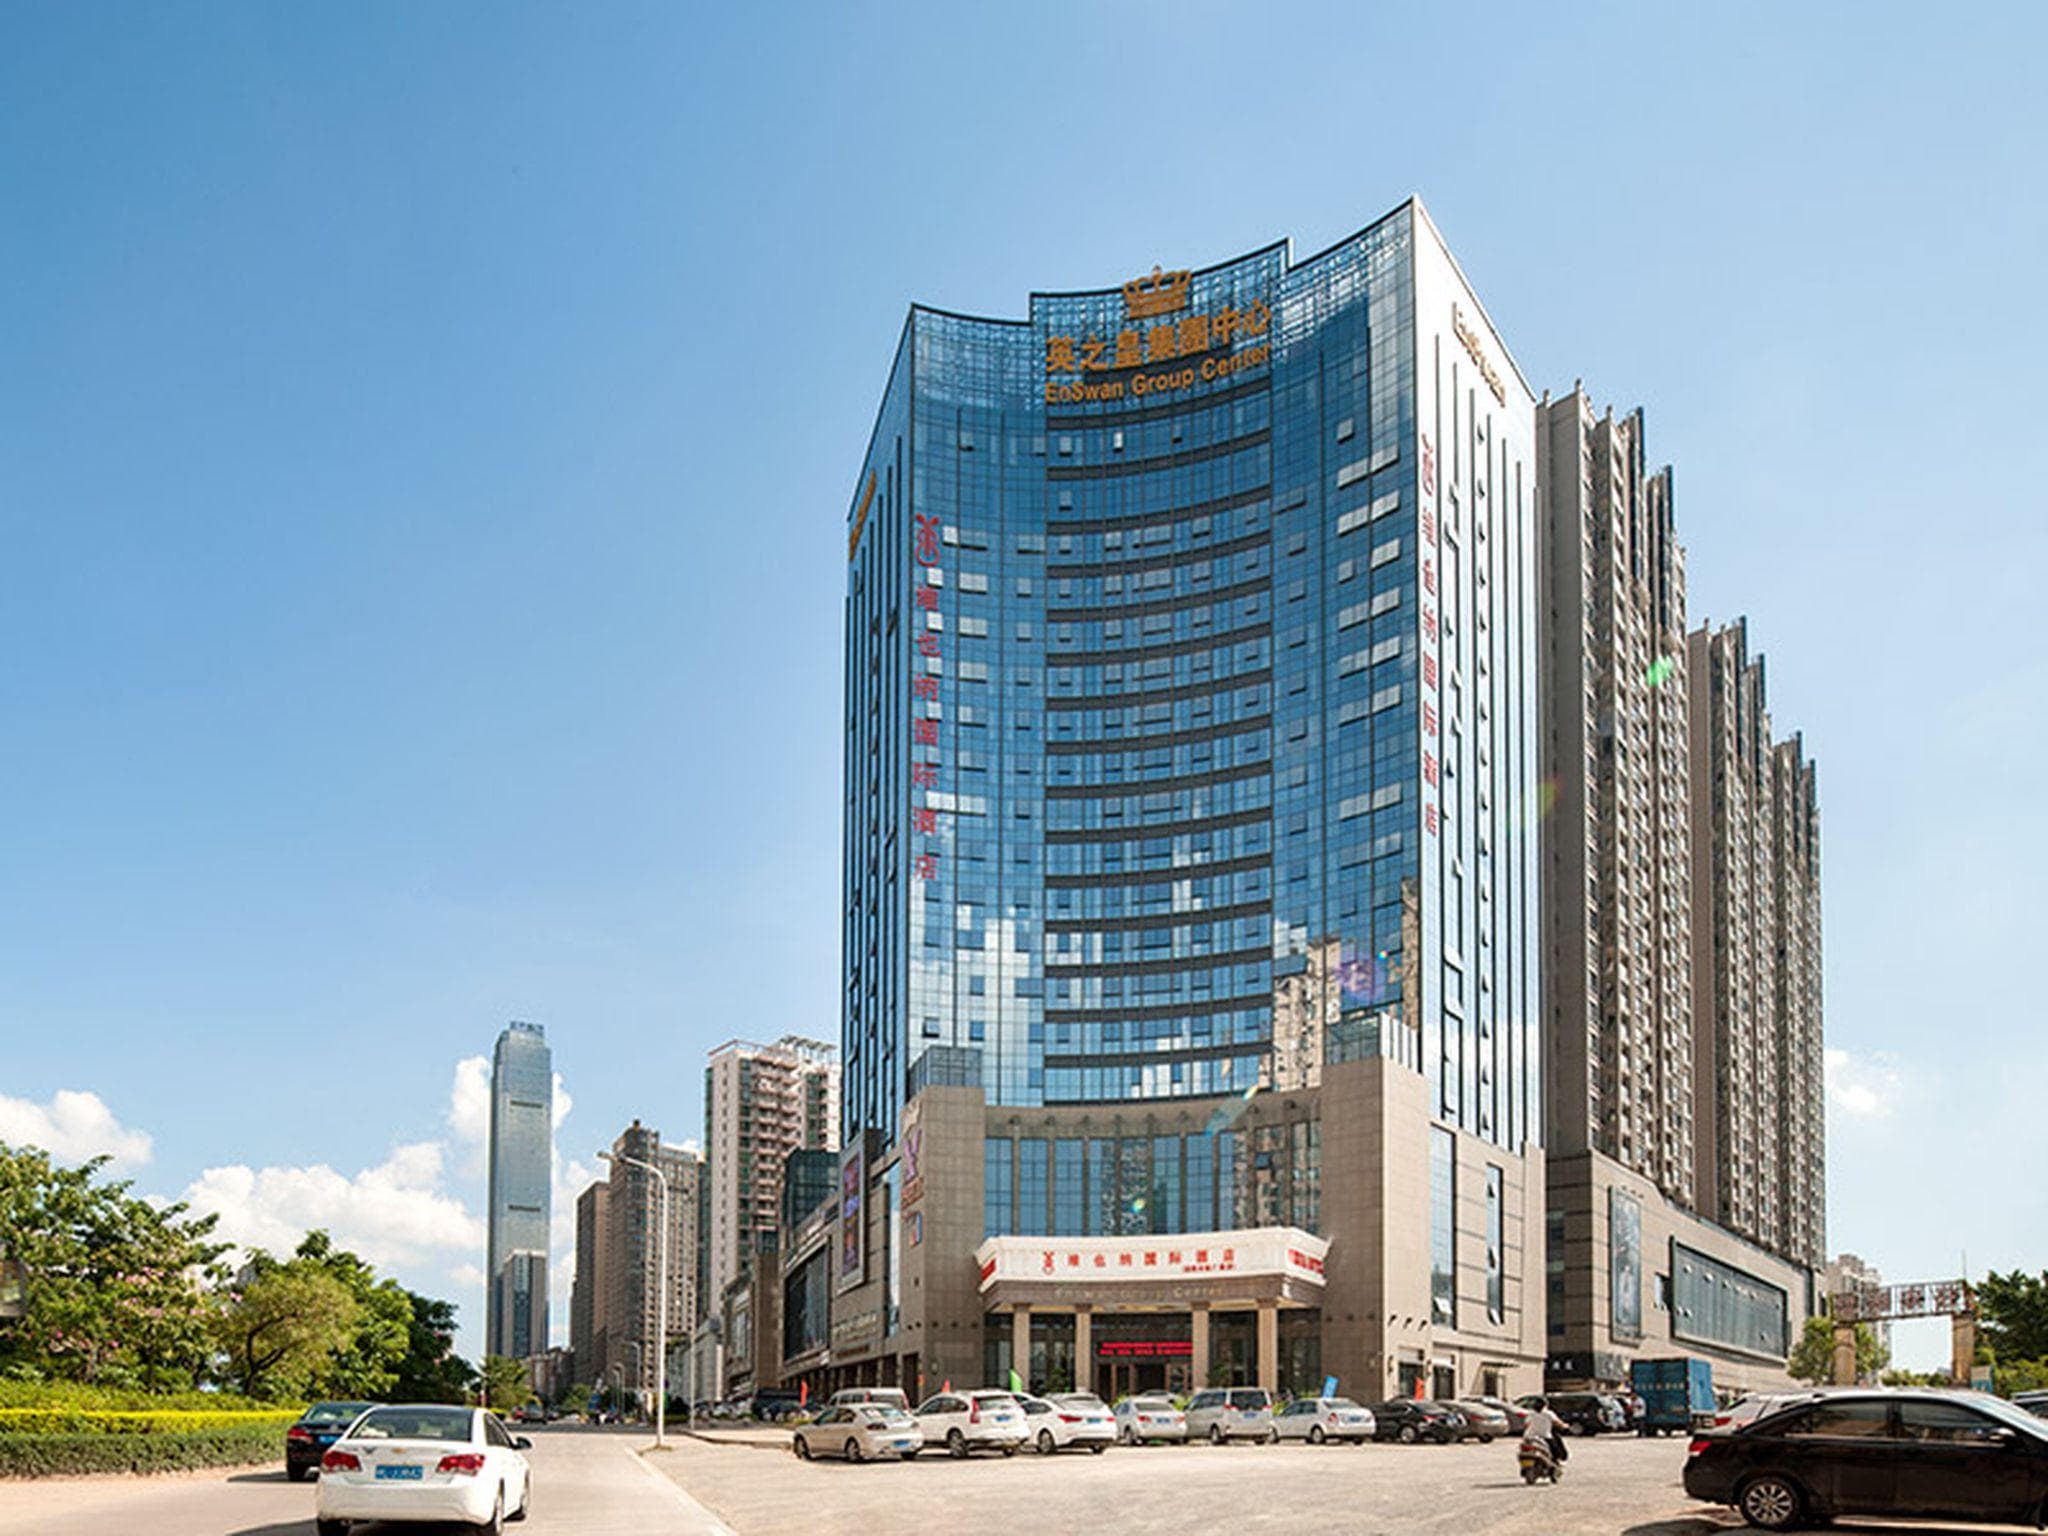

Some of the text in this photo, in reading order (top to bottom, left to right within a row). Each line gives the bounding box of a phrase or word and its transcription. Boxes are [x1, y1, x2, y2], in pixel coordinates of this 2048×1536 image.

[1045, 345, 1272, 403] EnSwan Group Center
